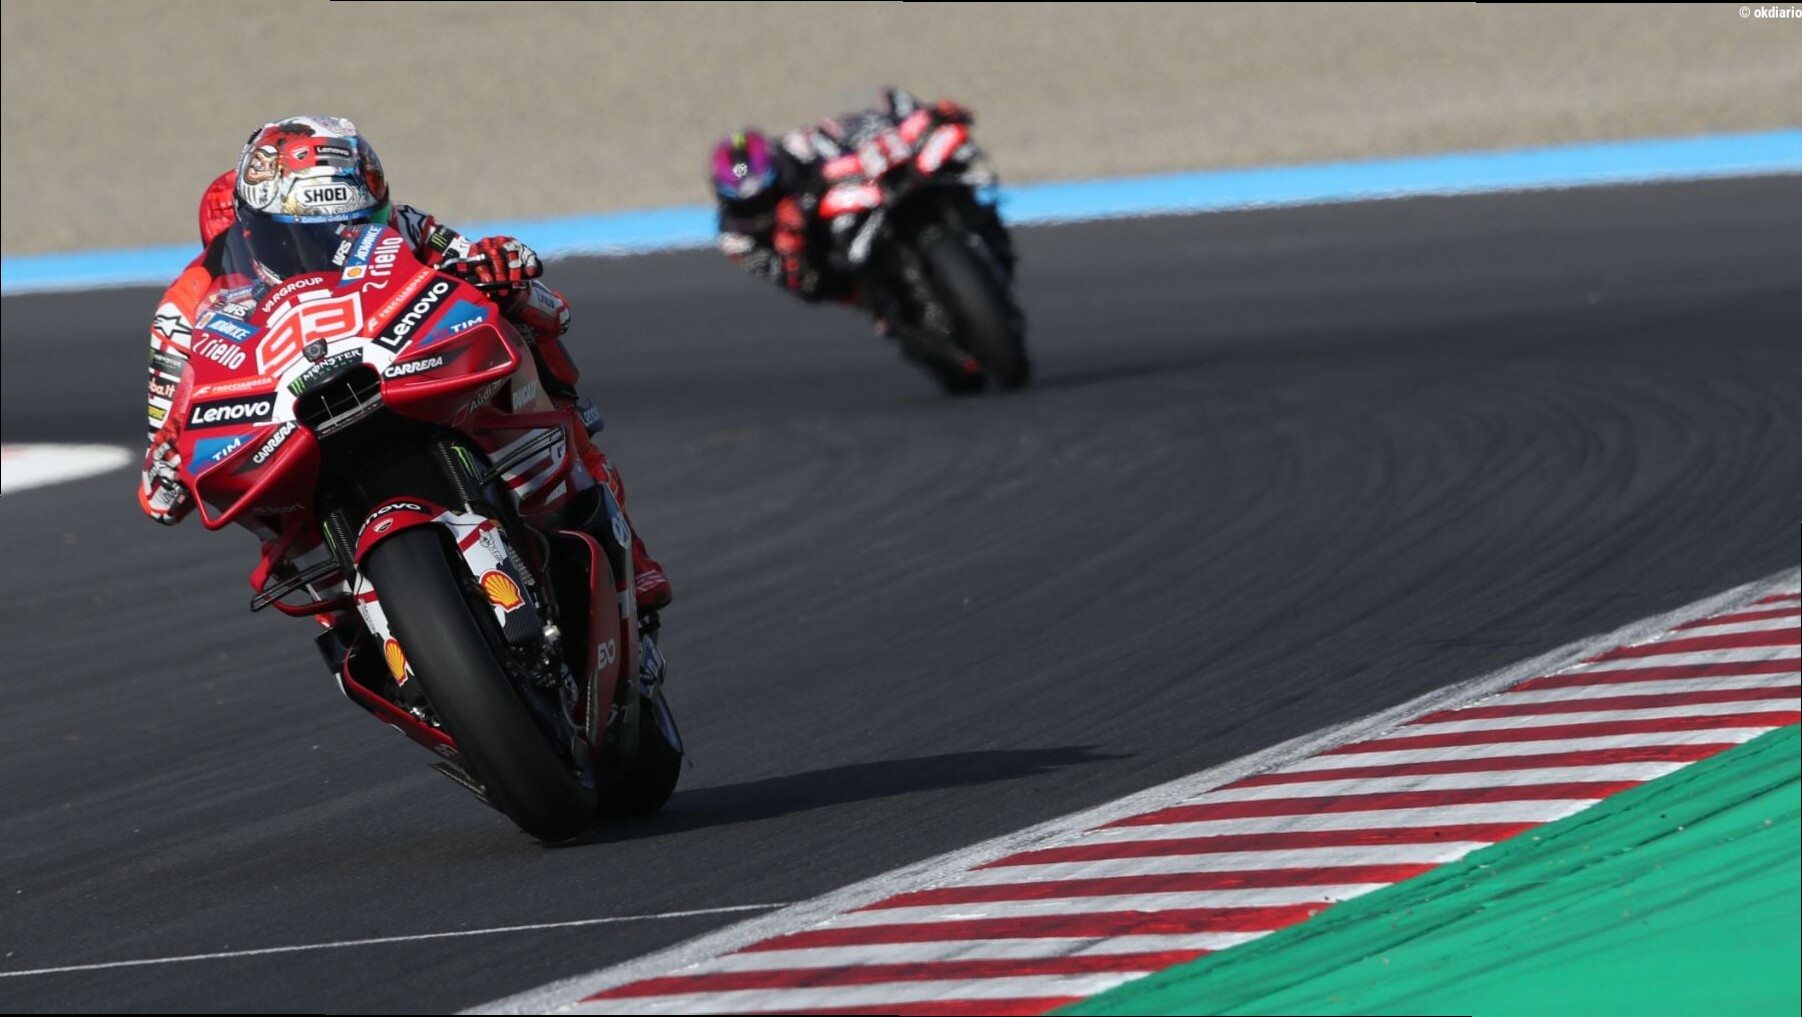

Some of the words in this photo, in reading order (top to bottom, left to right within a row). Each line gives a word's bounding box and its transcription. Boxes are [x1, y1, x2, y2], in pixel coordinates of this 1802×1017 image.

[303, 187, 347, 203] SHOEI
[368, 236, 404, 277] riello
[380, 281, 450, 347] Lenovo
[450, 315, 483, 333] TIM
[258, 296, 360, 379] 93
[199, 338, 247, 371] riello
[303, 348, 363, 381] MONSTER
[384, 356, 444, 378] CARRERA
[191, 401, 271, 425] Lenovo
[212, 437, 242, 461] TIM
[253, 420, 297, 463] CARRERA
